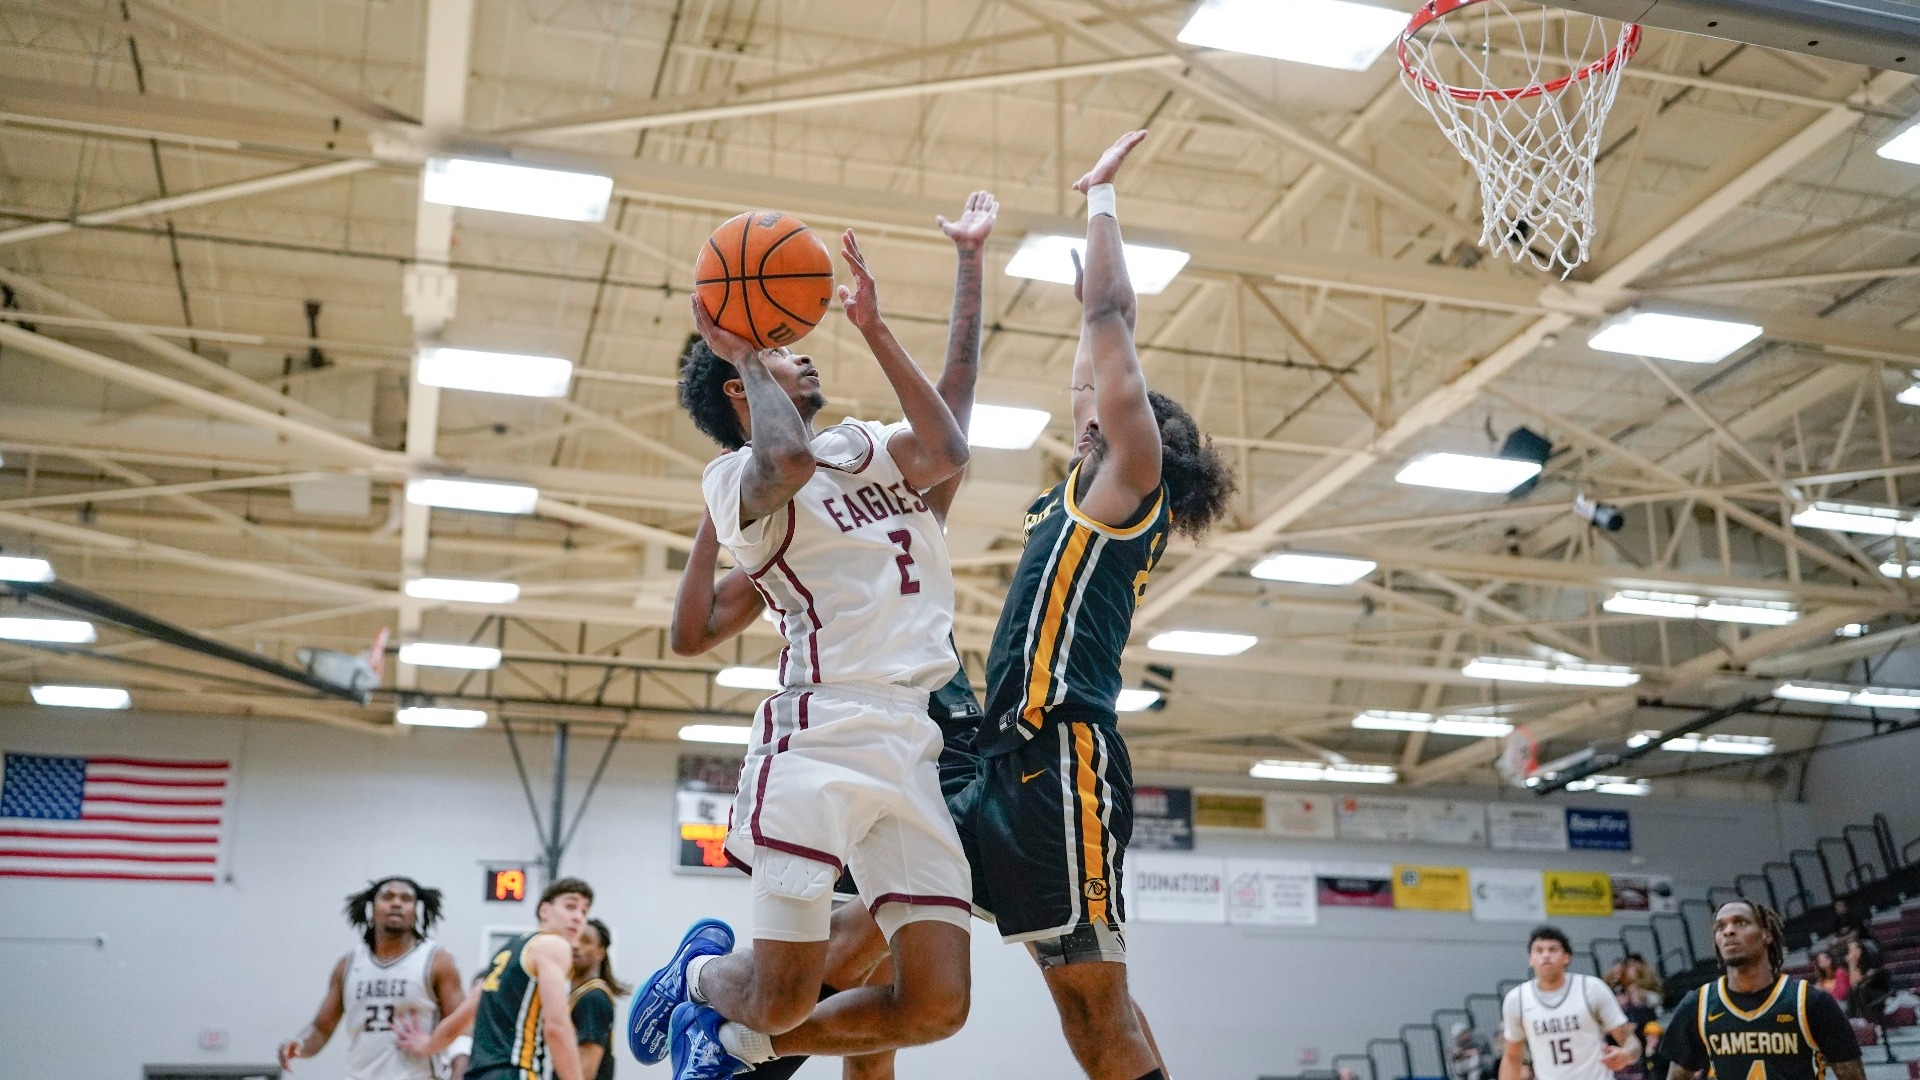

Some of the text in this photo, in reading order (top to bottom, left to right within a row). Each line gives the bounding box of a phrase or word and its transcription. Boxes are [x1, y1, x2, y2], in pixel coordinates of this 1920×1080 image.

[823, 479, 929, 533] EAGLES
[887, 529, 920, 595] 2
[495, 869, 525, 900] 19
[356, 979, 407, 1000] EAGLES
[365, 1004, 395, 1032] 23
[1533, 1014, 1580, 1035] EAGLES
[1549, 1037, 1573, 1065] 15
[1709, 1030, 1799, 1056] CAMERON
